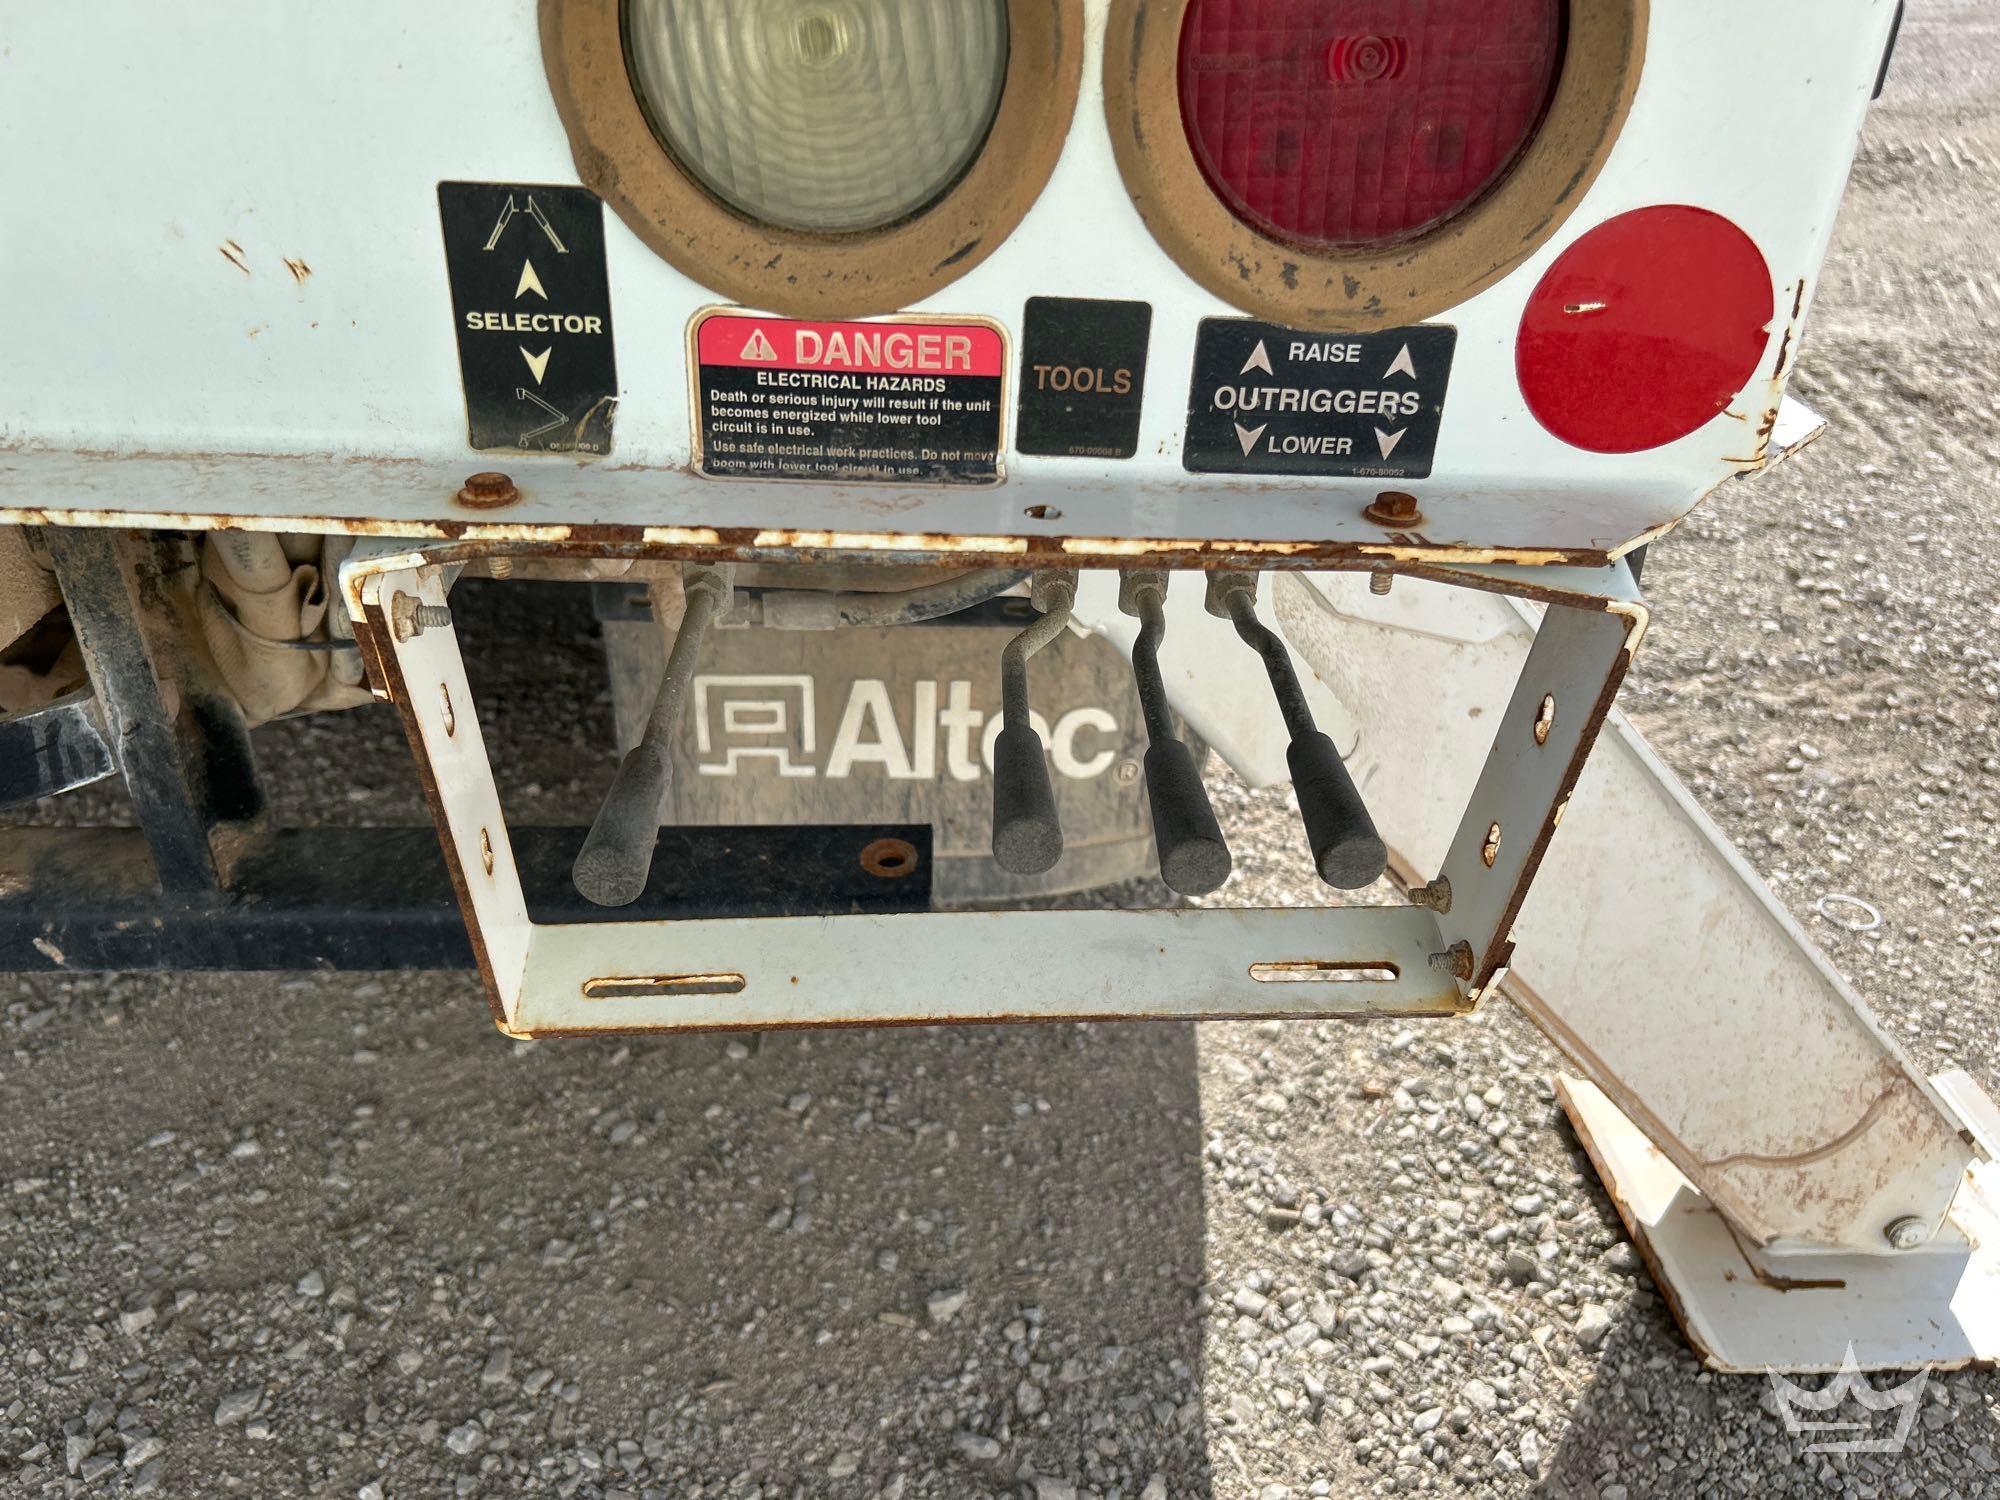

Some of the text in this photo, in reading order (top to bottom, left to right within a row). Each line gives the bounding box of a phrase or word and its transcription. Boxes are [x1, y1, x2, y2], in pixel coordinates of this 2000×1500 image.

[466, 311, 602, 335] SELECTOR
[795, 329, 972, 370] DANGER
[1288, 342, 1361, 363] RAISE
[757, 371, 946, 392] ELECTRICAL HAZARDS
[1033, 365, 1131, 394] TOOLS
[710, 389, 991, 412] Death or serious injury will result if the unit
[1213, 385, 1420, 415] OUTRIGGERS
[711, 405, 942, 425] becomes energized while lower tool
[712, 421, 815, 437] circuit is in use.
[713, 440, 736, 453] Use
[740, 442, 765, 454] safe
[768, 443, 823, 457] electrical
[827, 446, 856, 458] work
[859, 447, 917, 461] practices.
[921, 449, 937, 461] Do
[941, 450, 961, 462] not
[1268, 435, 1353, 456] LOWER
[713, 458, 746, 469] boom
[750, 459, 775, 470] with
[779, 459, 811, 471] lower
[815, 462, 839, 473] tool
[884, 464, 895, 475] in
[898, 466, 924, 476] use.
[1352, 467, 1406, 477] 1-670-80052
